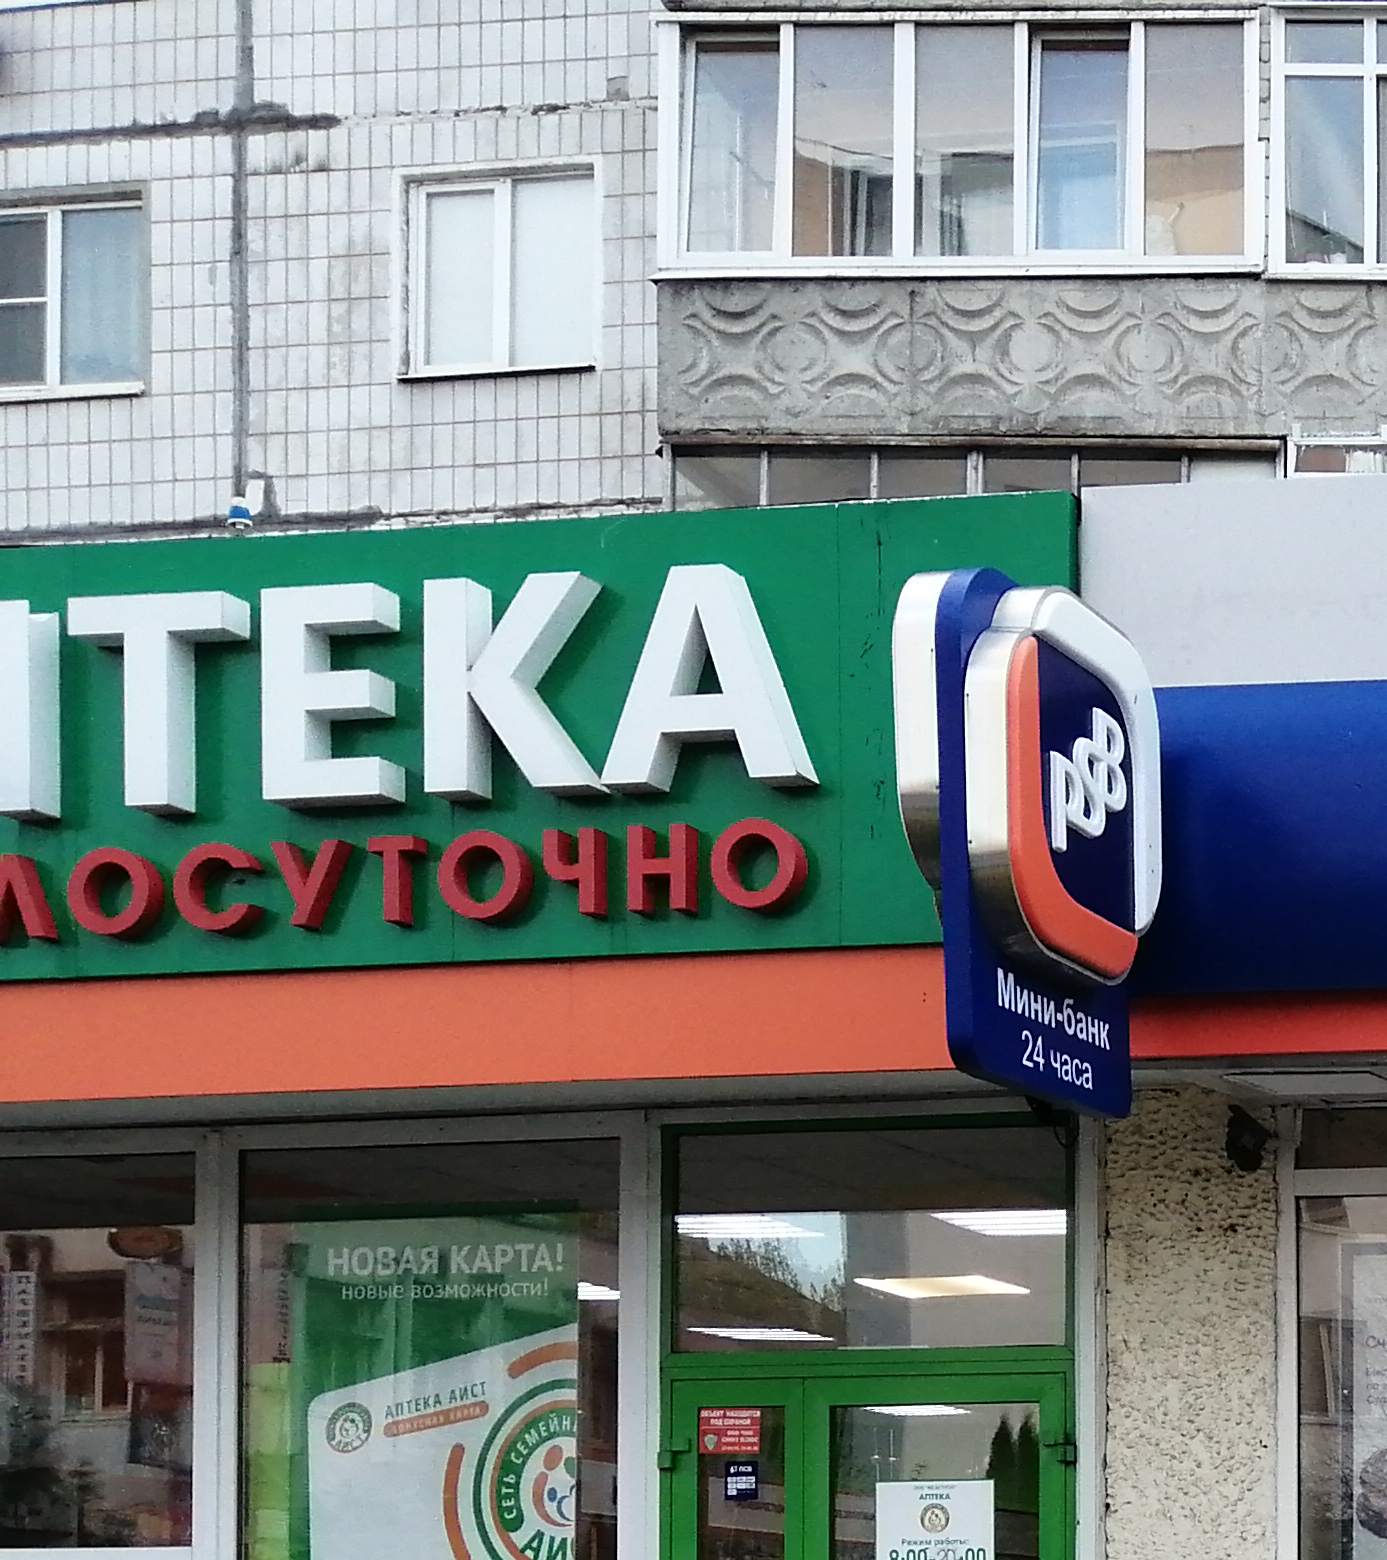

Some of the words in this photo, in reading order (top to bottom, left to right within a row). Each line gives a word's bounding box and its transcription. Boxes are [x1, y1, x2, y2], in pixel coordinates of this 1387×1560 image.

[0, 563, 821, 822] ТЕКА
[997, 966, 1111, 1052] Мини-банк
[1022, 1029, 1045, 1071] 24
[1049, 1044, 1093, 1091] часа
[326, 1246, 440, 1277] НОВАЯ
[449, 1243, 563, 1275] КАРТА!
[341, 1284, 404, 1300] новые
[410, 1278, 549, 1299] возможности!
[384, 1392, 443, 1420] АПТЕКА
[449, 1381, 488, 1406] АИСТ
[502, 1473, 516, 1519] СЕТЬ
[918, 1493, 951, 1501] АПТЕКА
[901, 1538, 931, 1547] Режим
